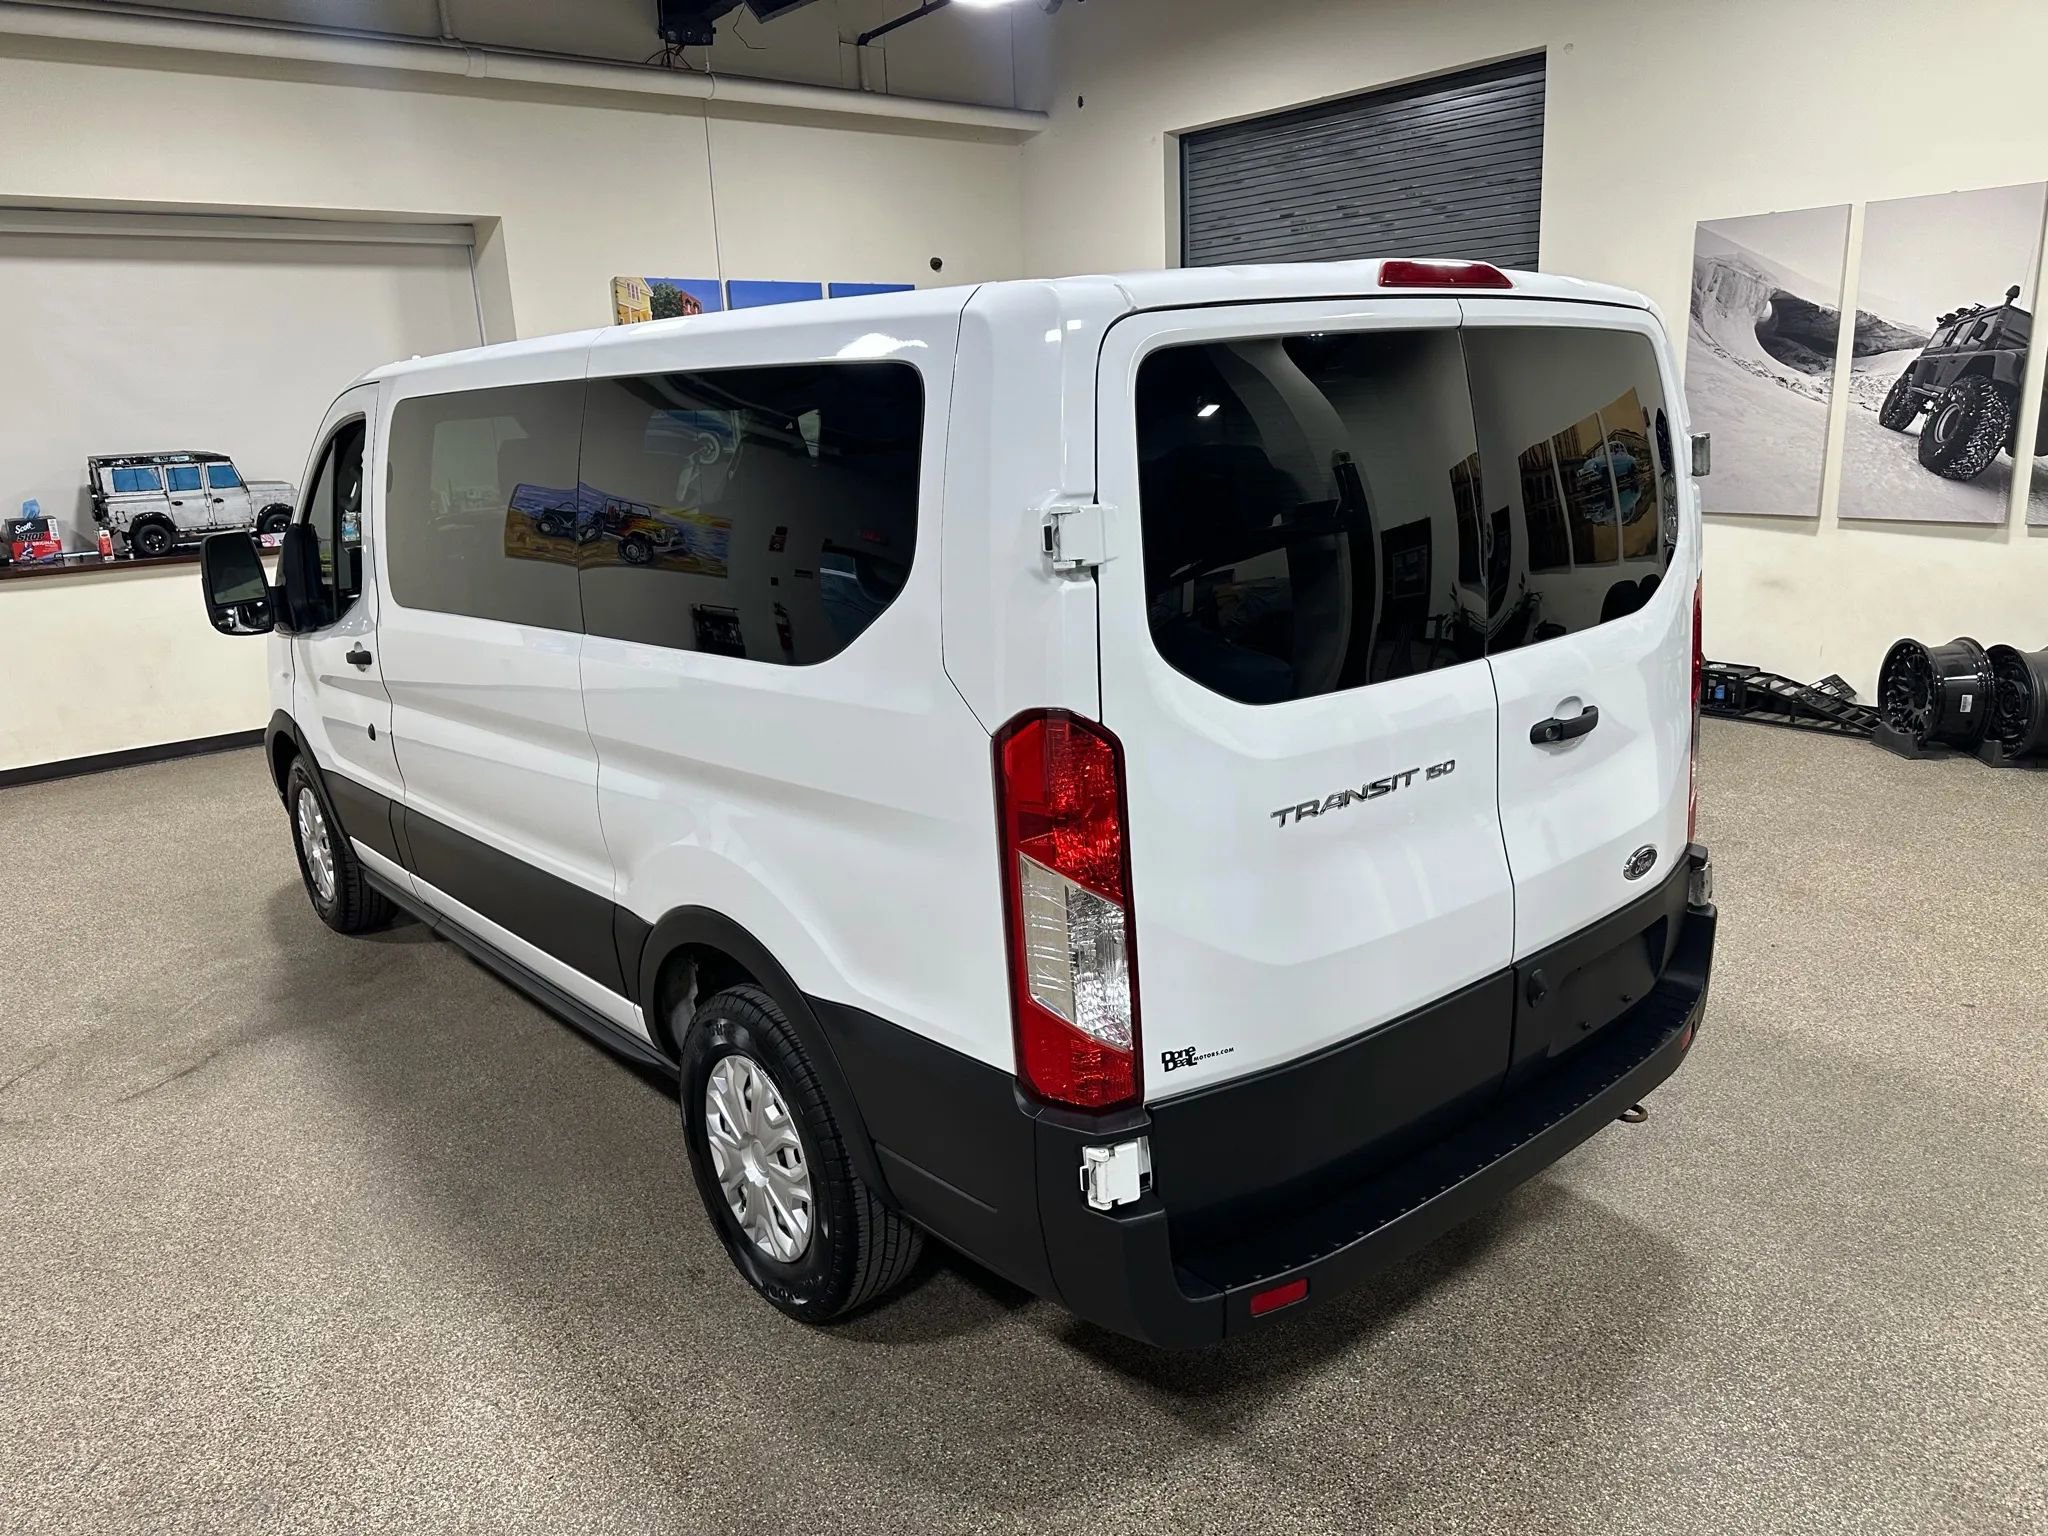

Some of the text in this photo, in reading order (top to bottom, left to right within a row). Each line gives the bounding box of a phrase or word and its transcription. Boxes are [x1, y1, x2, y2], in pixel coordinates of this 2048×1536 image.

[15, 521, 35, 534] Scott
[16, 532, 45, 542] SHOP
[1270, 759, 1456, 828] TRANSIT 150
[1161, 1046, 1196, 1063] Done
[1193, 1047, 1235, 1061] MOTORS.COM
